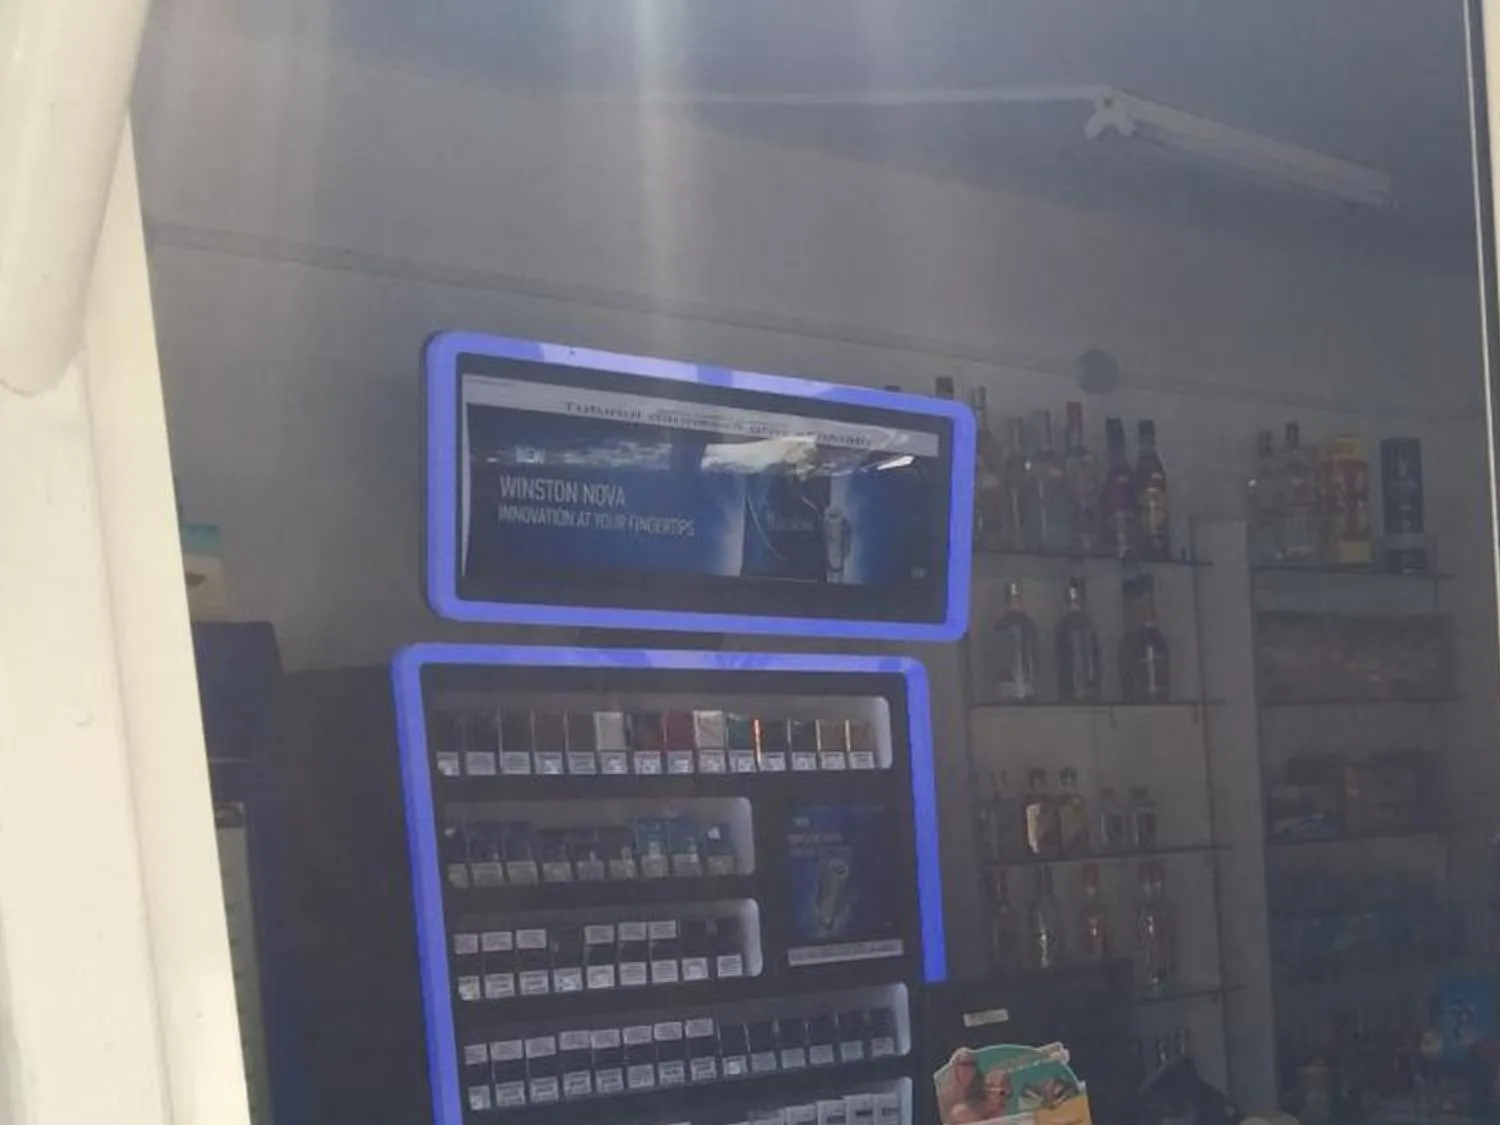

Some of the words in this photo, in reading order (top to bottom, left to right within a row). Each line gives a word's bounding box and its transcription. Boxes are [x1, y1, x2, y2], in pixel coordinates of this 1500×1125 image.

[499, 474, 578, 504] WINSTON
[582, 482, 626, 508] NOVA
[498, 504, 572, 529] INNOVATION
[575, 510, 592, 529] AT
[594, 511, 628, 531] YOUR
